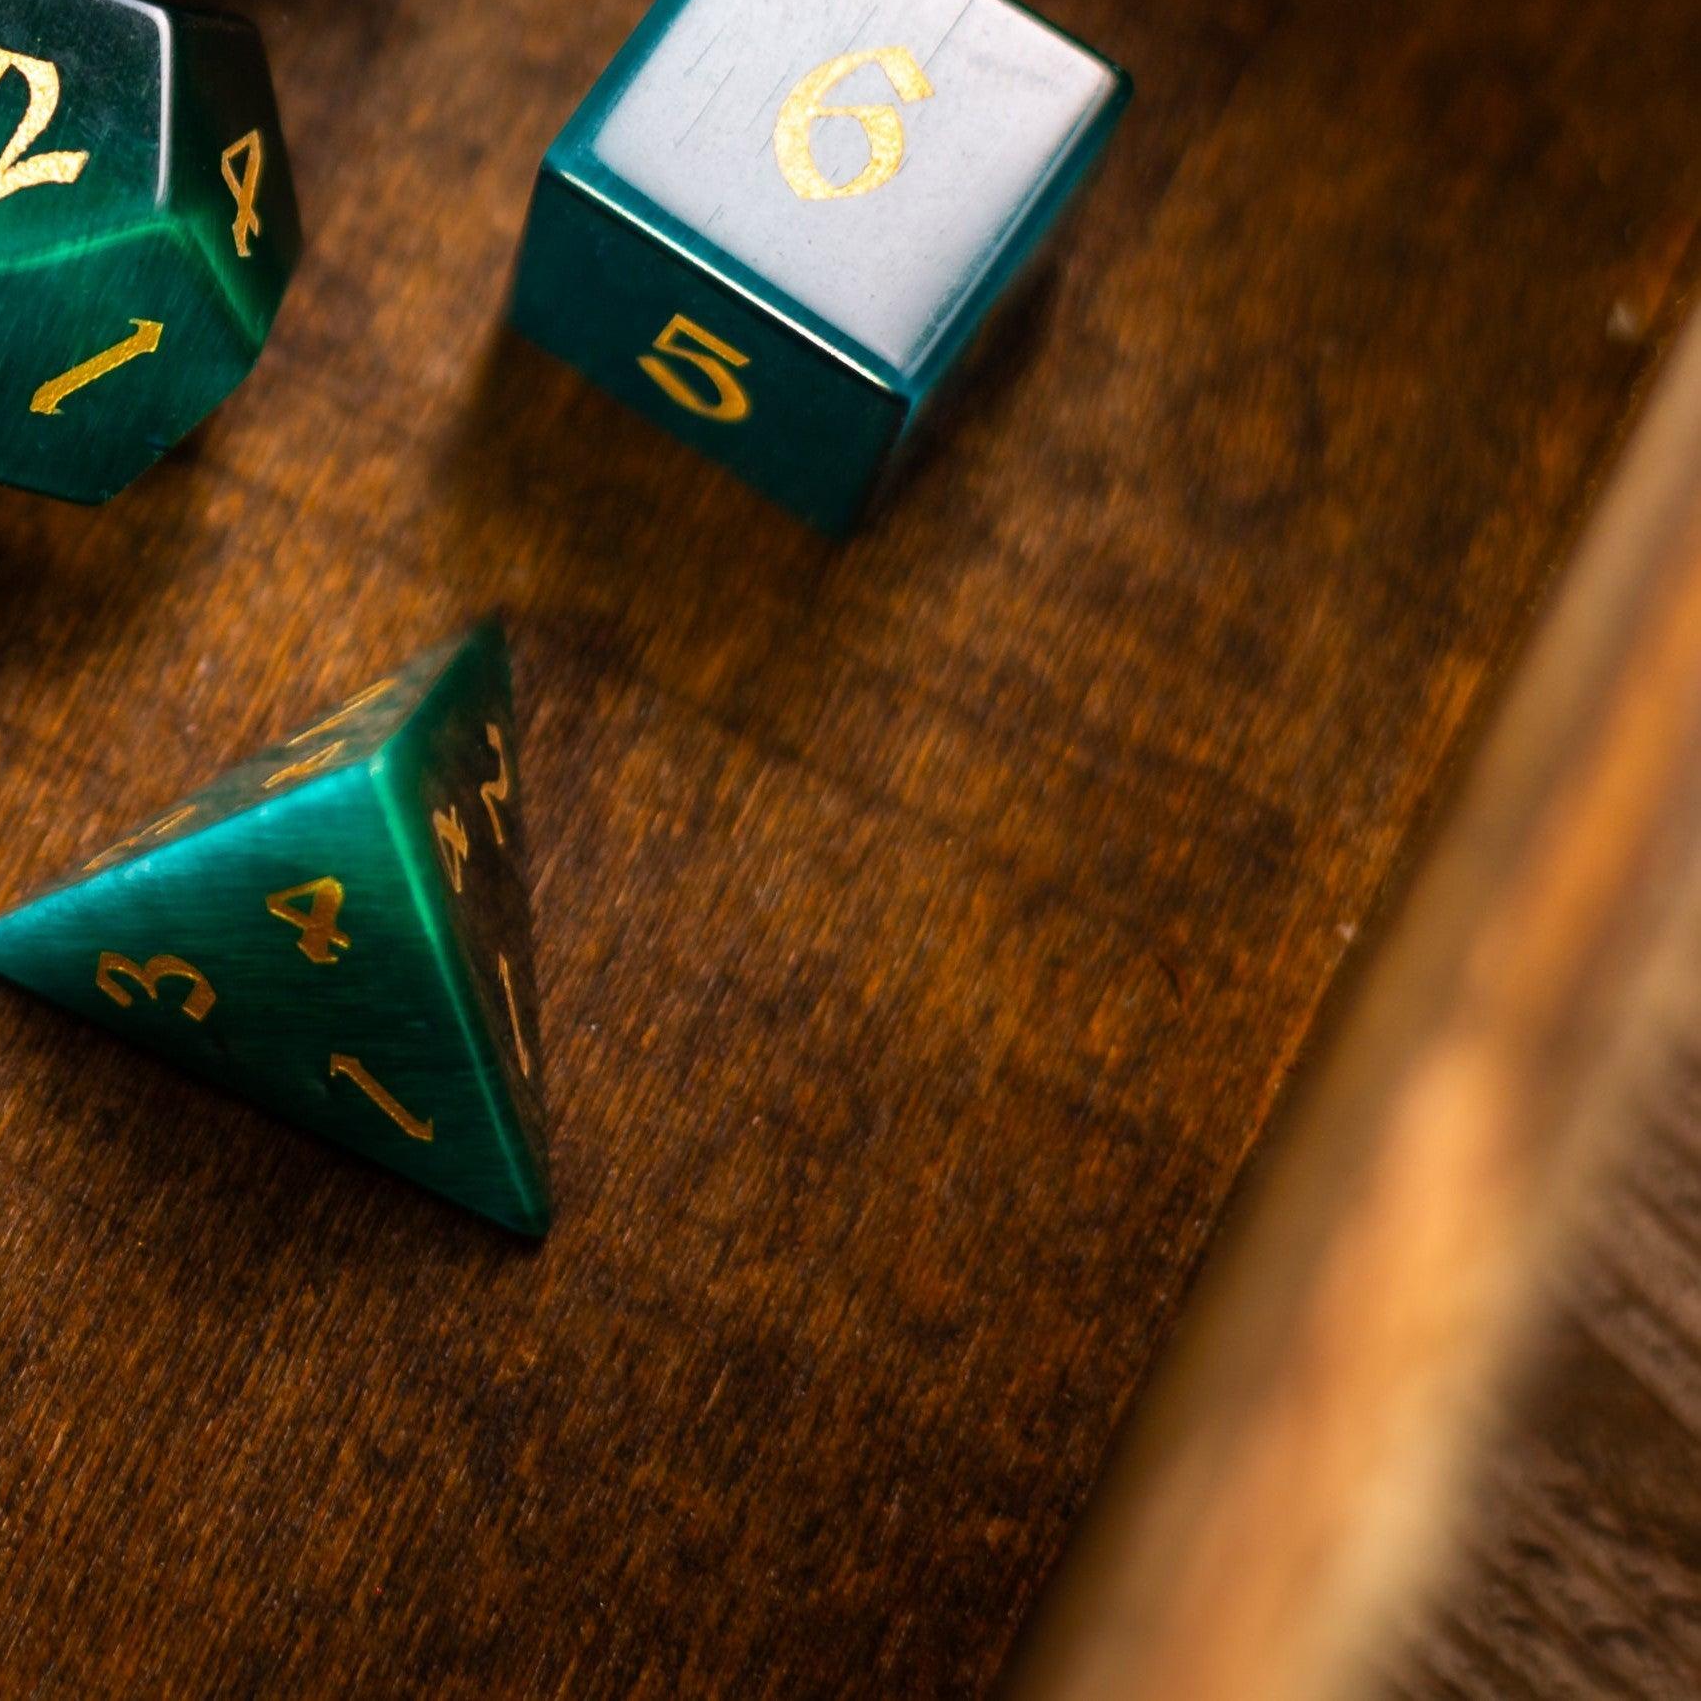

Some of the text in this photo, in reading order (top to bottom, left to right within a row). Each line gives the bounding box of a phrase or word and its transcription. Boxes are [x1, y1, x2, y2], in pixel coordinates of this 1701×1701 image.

[773, 45, 936, 200] 6
[221, 129, 261, 258] 4
[29, 317, 164, 415] 1
[637, 313, 752, 422] 5
[266, 875, 352, 963] 4
[96, 951, 216, 1022] 3
[330, 1053, 434, 1143] 1
